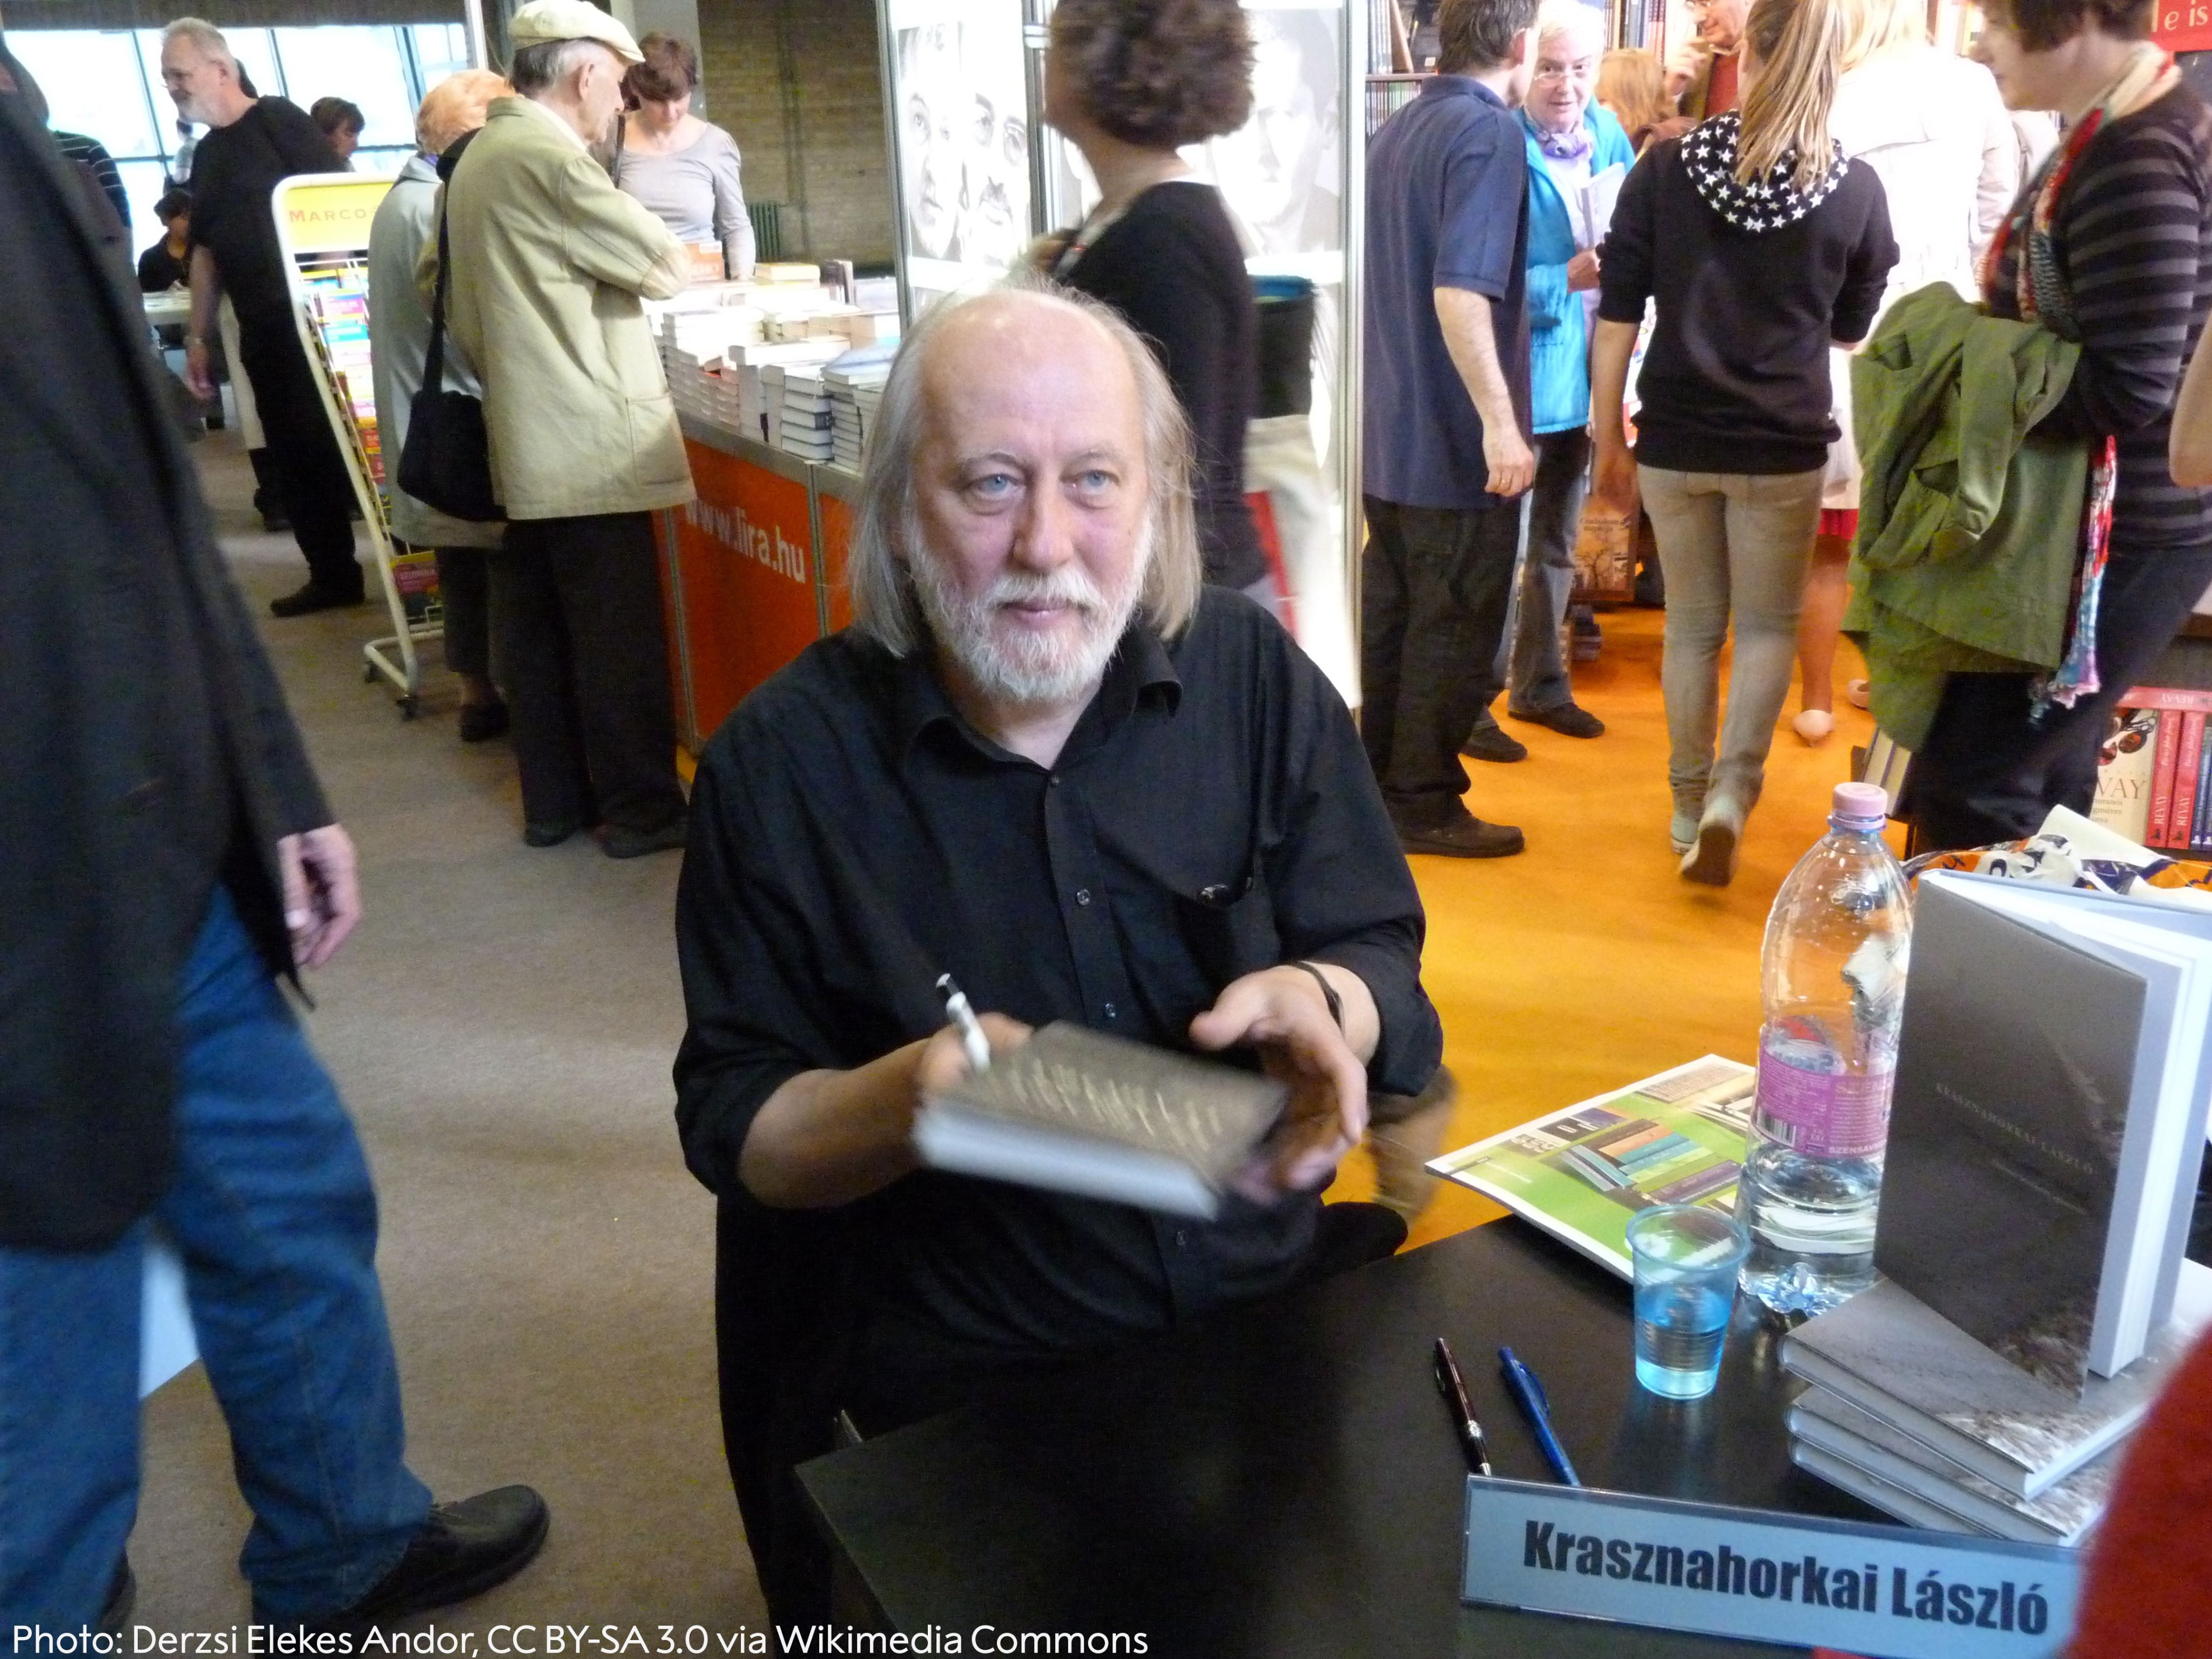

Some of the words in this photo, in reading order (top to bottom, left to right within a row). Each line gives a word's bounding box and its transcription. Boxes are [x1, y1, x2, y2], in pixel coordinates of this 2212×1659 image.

[288, 208, 367, 223] MARCO
[685, 498, 806, 584] www.lira.hu
[1523, 1520, 1879, 1613] Krasznahorkai
[1891, 1567, 2048, 1635] László
